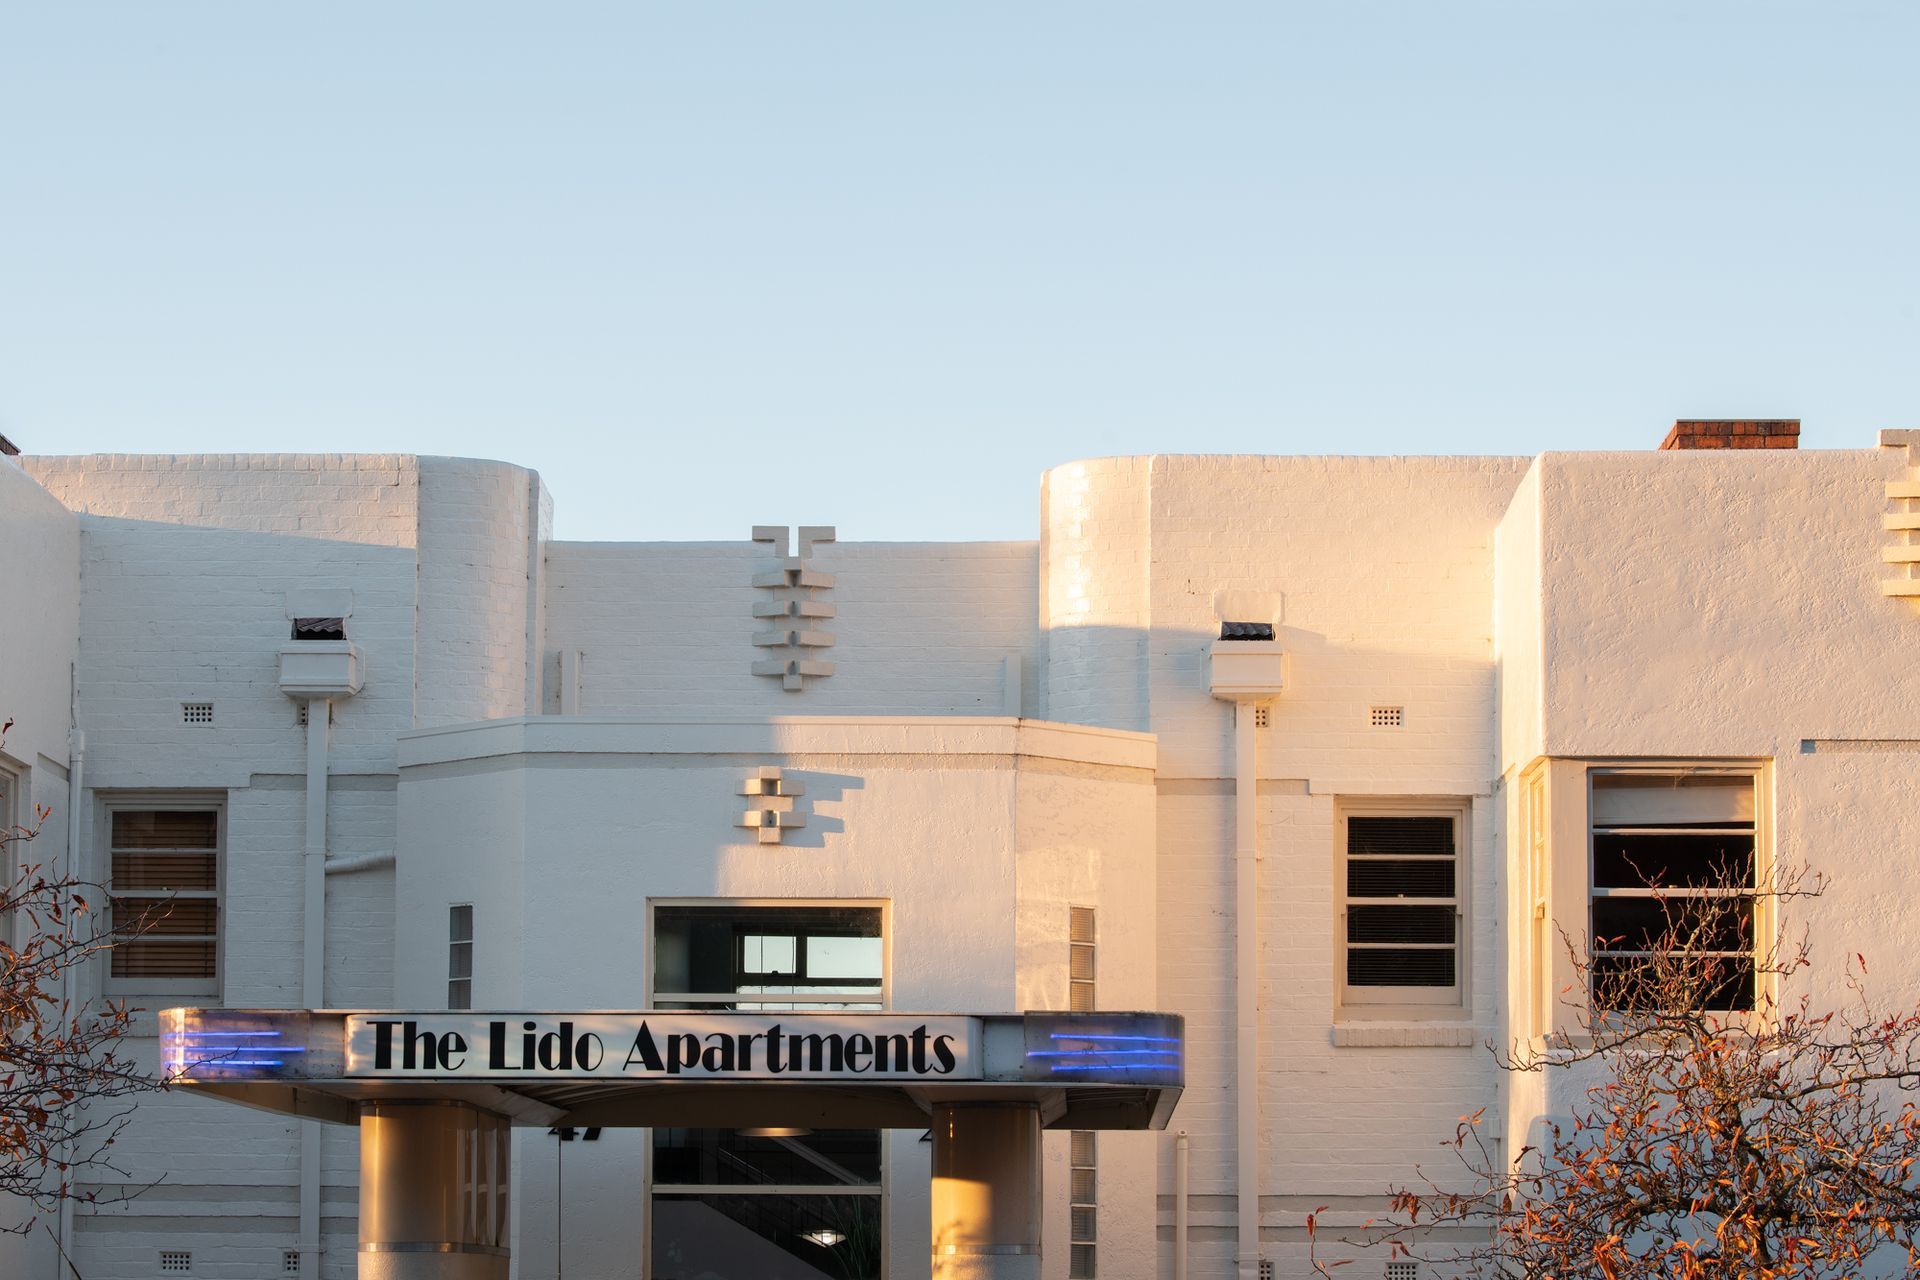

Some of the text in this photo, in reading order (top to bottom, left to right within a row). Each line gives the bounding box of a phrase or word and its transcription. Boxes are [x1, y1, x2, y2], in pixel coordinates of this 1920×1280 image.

[366, 1020, 955, 1074] The Lido Apartments
